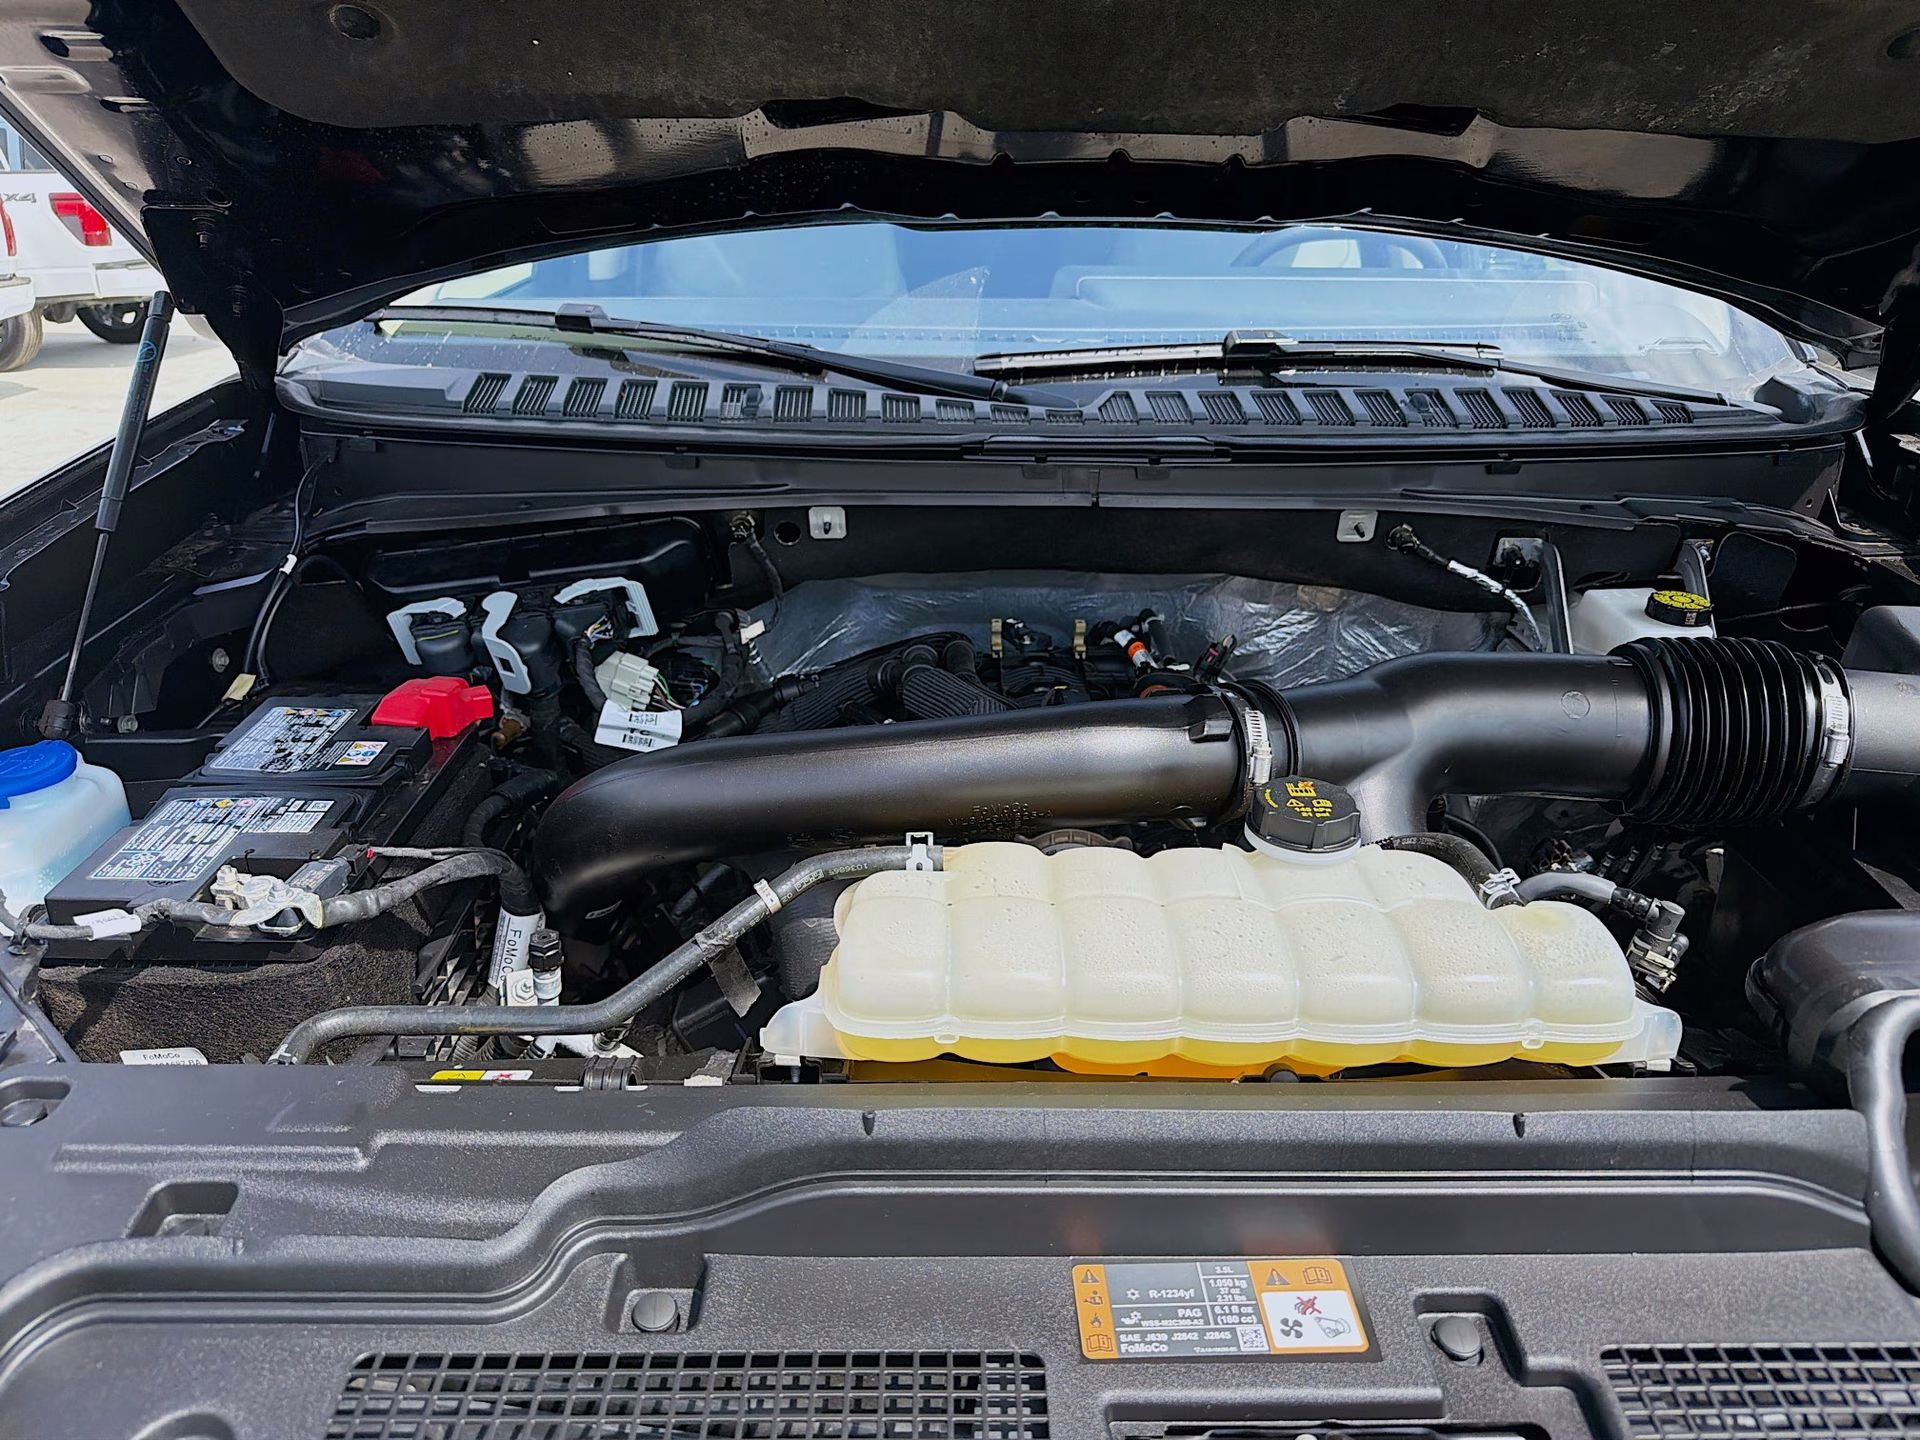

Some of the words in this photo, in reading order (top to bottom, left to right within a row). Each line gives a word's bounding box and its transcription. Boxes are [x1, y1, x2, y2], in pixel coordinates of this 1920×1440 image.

[142, 1052, 181, 1060] FoMoCo
[1209, 1279, 1233, 1288] 1.050
[1234, 1278, 1248, 1288] kg
[1149, 1288, 1195, 1300] R-1234yf
[1177, 1308, 1203, 1318] PAG
[1213, 1305, 1230, 1314] 6.1
[1240, 1314, 1258, 1324] cc)
[1119, 1333, 1141, 1342] SAE
[1144, 1332, 1168, 1342] J639
[1120, 1343, 1168, 1353] FoMoCo
